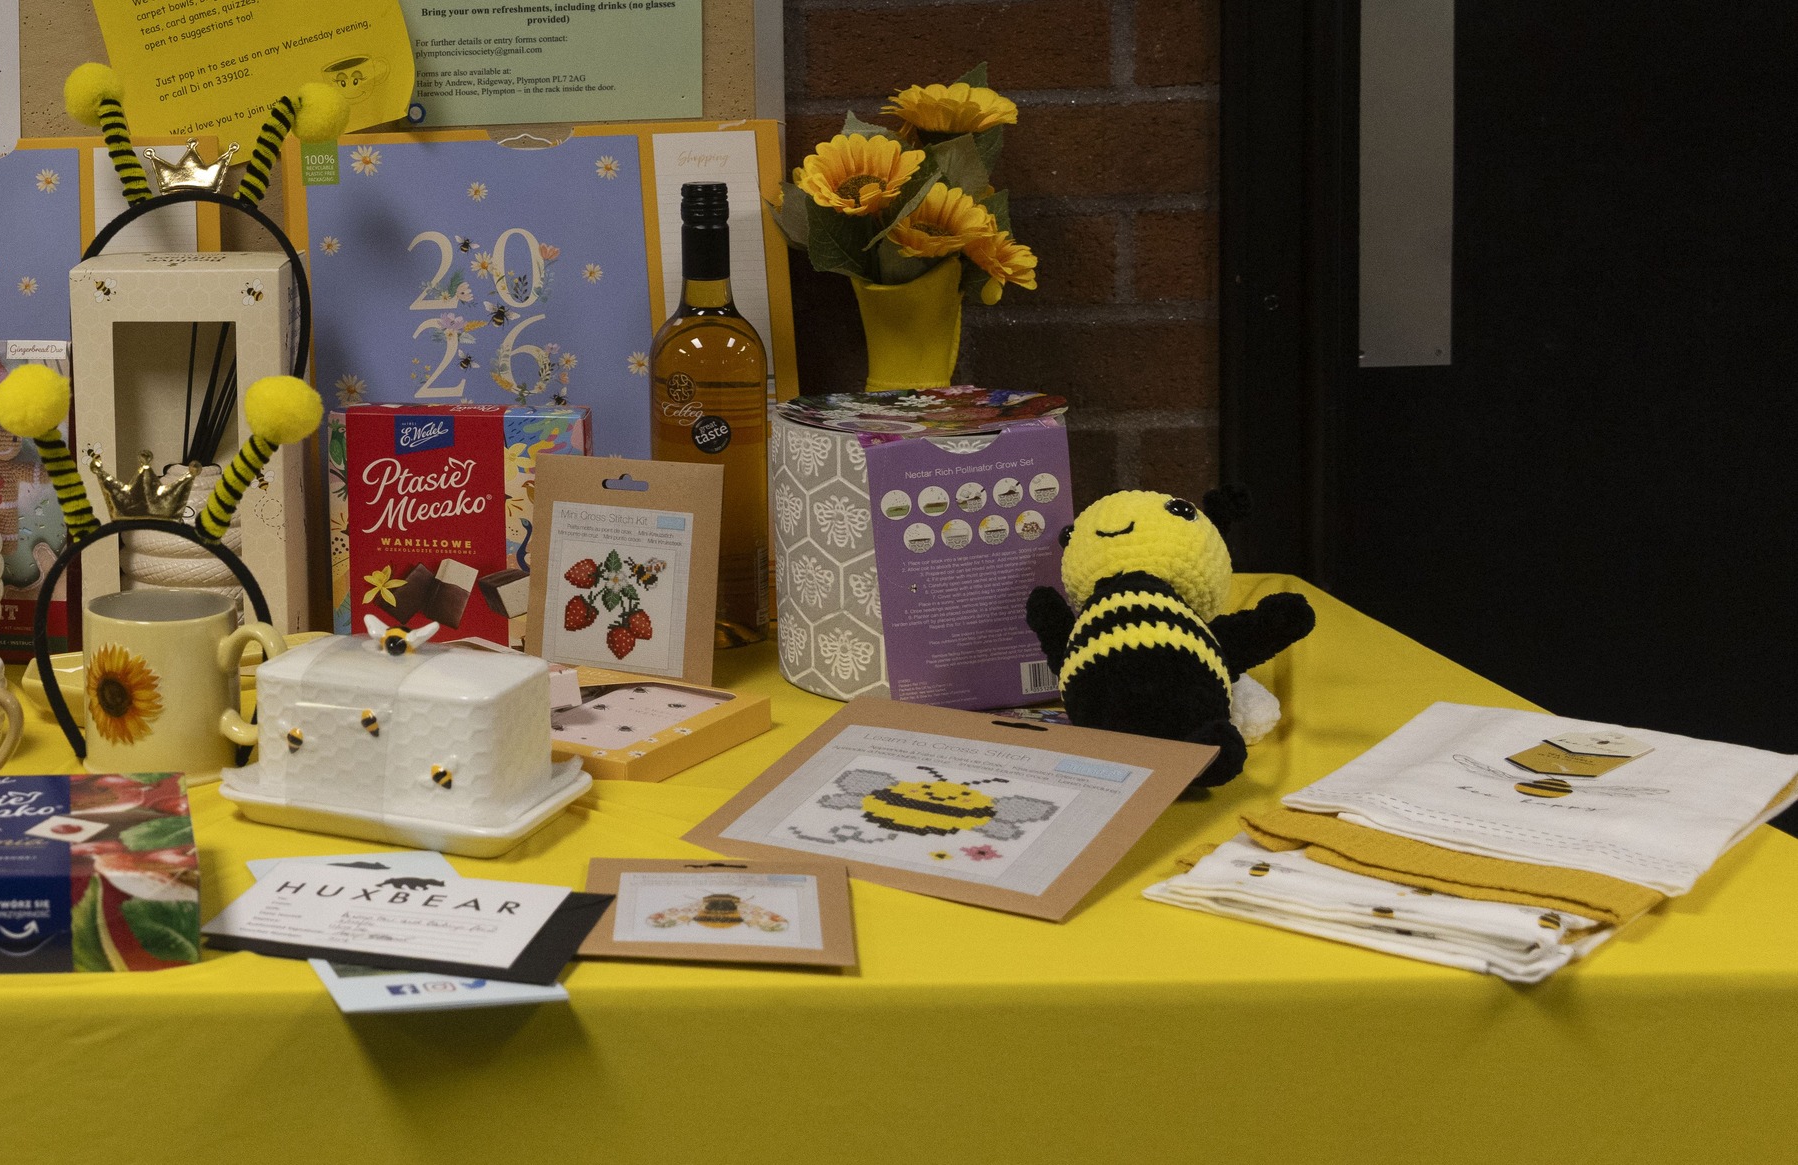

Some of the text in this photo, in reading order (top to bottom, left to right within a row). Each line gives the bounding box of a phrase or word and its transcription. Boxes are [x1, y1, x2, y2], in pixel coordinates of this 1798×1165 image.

[422, 8, 447, 17] Bring
[449, 9, 469, 18] your
[492, 5, 552, 14] refreshments,
[555, 3, 596, 12] including
[598, 2, 627, 10] drinks
[629, 2, 643, 10] (no
[646, 0, 676, 10] glasses
[527, 15, 570, 26] provided)
[156, 75, 176, 87] Just
[178, 71, 195, 83] pop
[220, 59, 237, 68] see
[238, 54, 249, 63] us
[251, 51, 263, 59] on
[264, 46, 280, 56] any
[282, 31, 333, 50] Wednesday
[160, 94, 169, 102] or
[172, 86, 188, 98] call
[190, 83, 200, 93] Di
[203, 81, 214, 89] on
[304, 155, 335, 165] 100%
[678, 150, 728, 169] Shopping
[406, 228, 544, 310] 20
[9, 344, 49, 357] Gingerbread
[414, 314, 551, 399] 26
[695, 425, 728, 445] taste
[699, 421, 717, 434] great
[905, 458, 1034, 479] Nectar Rich Pollinator Grow Set
[362, 457, 477, 505] Ptasie
[581, 511, 606, 521] Cross
[609, 514, 633, 524] Stitch
[636, 517, 648, 525] Kit
[381, 537, 472, 549] WANILIOWE
[932, 742, 979, 756] Cross
[985, 748, 1031, 762] Stitch
[275, 880, 523, 915] HUXBEAR
